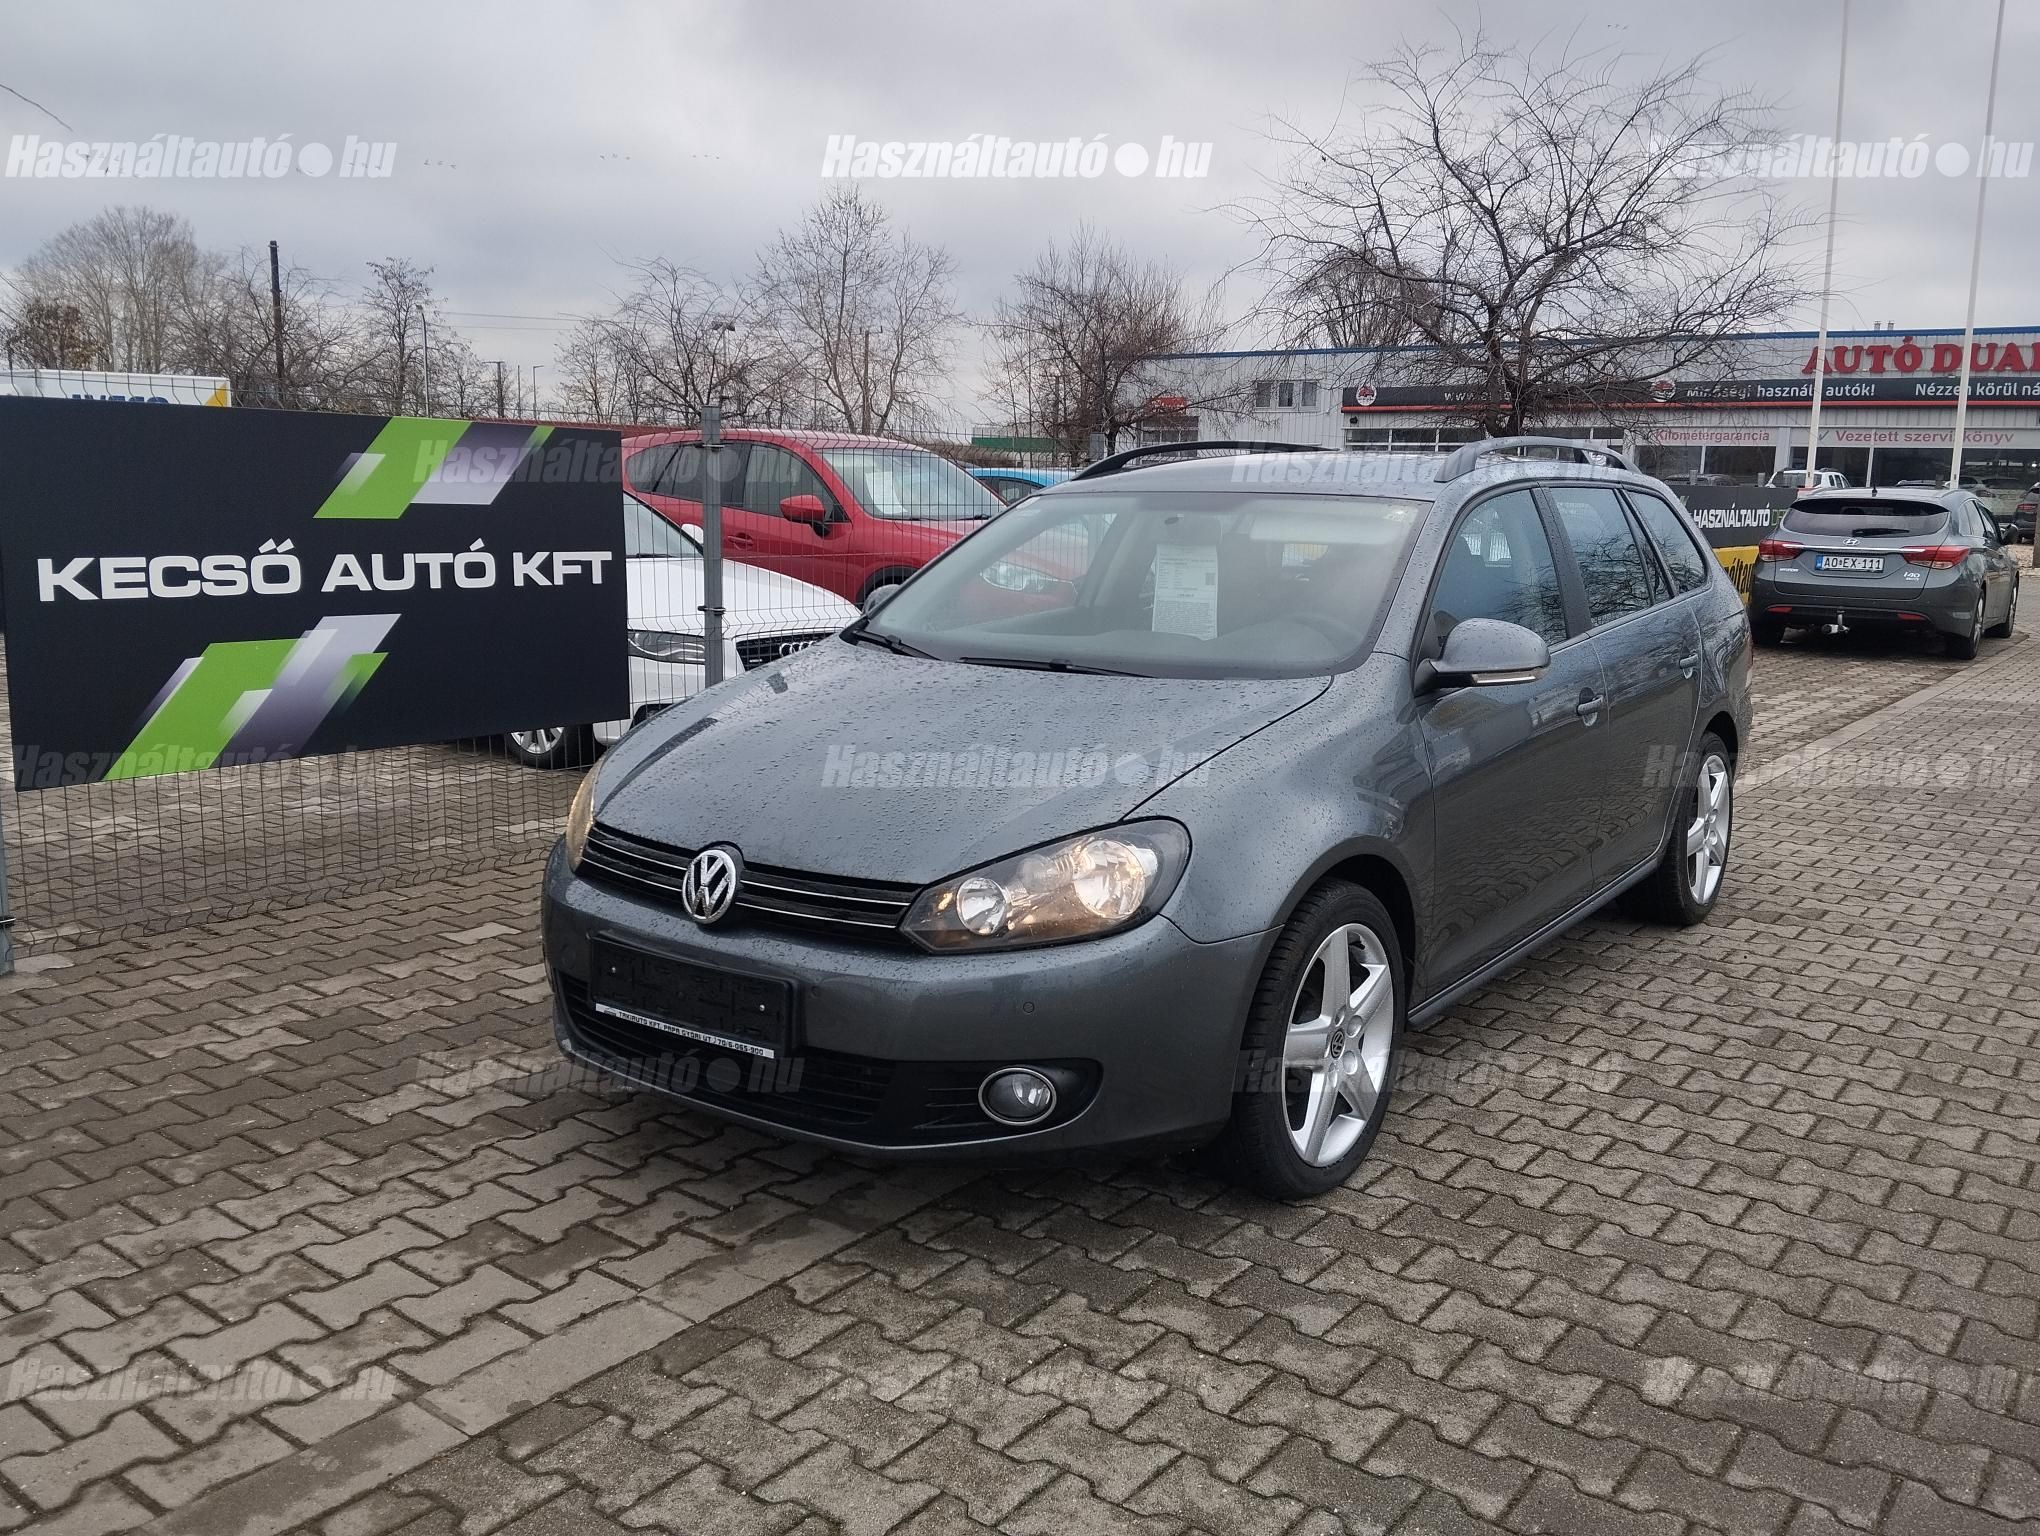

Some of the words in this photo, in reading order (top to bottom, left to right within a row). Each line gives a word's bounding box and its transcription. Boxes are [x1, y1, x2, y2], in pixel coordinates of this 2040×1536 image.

[1802, 336, 1923, 374] AUTÓ
[1757, 384, 1815, 397] használ
[1826, 383, 1876, 397] autók!
[1976, 382, 2018, 396] körül
[1835, 430, 1899, 442] Vezetett
[38, 538, 301, 601] KECSŐ
[320, 537, 497, 592] AUTÓ
[513, 551, 613, 586] KFT
